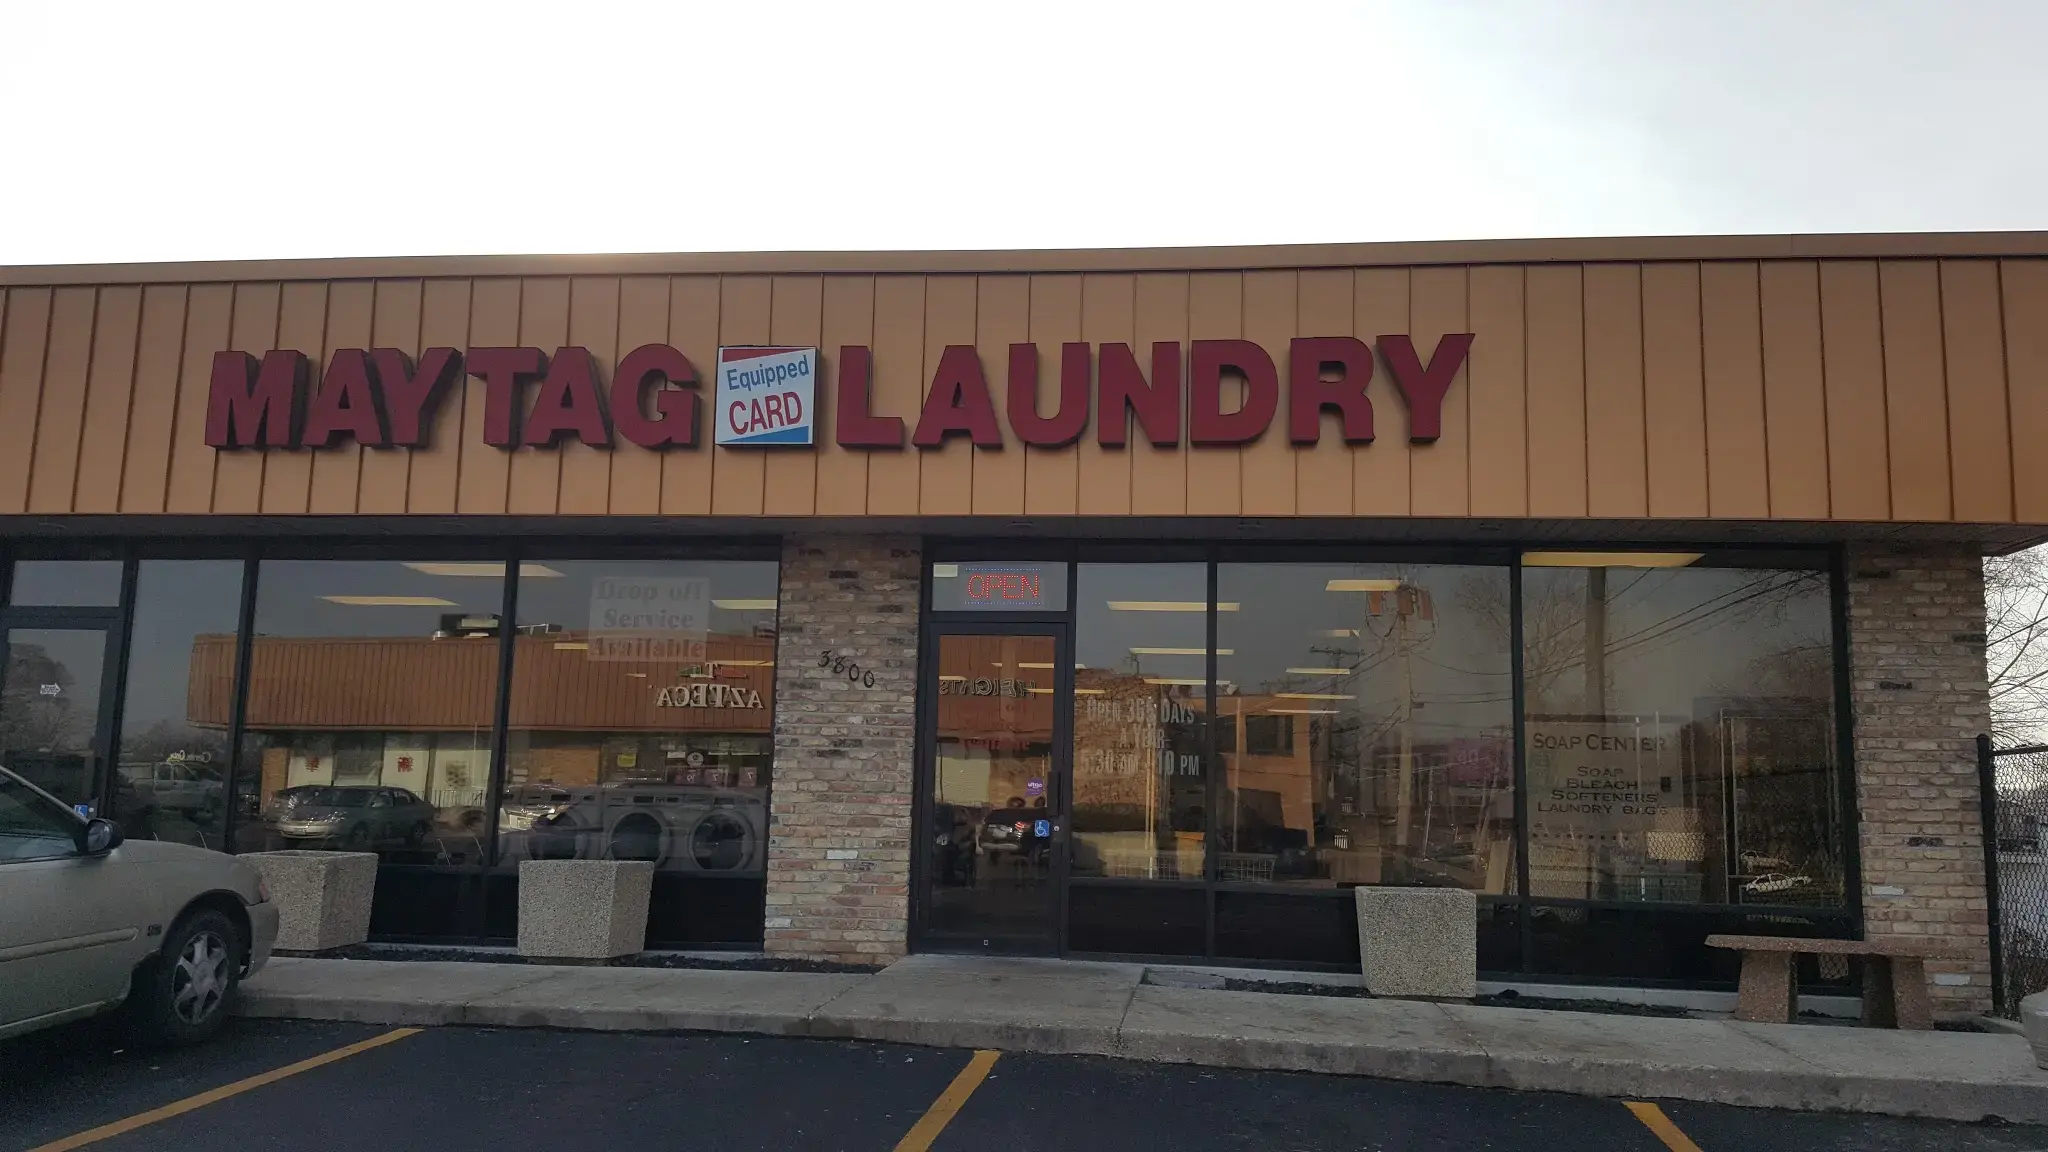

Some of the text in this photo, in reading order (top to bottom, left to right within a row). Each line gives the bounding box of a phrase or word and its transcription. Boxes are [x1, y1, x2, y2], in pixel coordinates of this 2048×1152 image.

[726, 354, 810, 391] Equipped
[205, 333, 1475, 449] MAYTAG LAUNDRY
[729, 391, 803, 435] CARD
[596, 581, 658, 605] Drop
[967, 574, 1040, 599] OPEN
[603, 608, 695, 628] Service
[817, 650, 875, 689] 3800
[1087, 697, 1122, 723] OPEN
[1161, 698, 1196, 724] DAYS
[1533, 733, 1666, 752] SOAP CENTER
[1180, 754, 1200, 777] PM
[1577, 765, 1624, 778] SOAP
[1566, 777, 1639, 790] BLEACH
[1550, 789, 1659, 803] SOFTENERS
[1537, 801, 1669, 816] LAUNDRY BAGS
